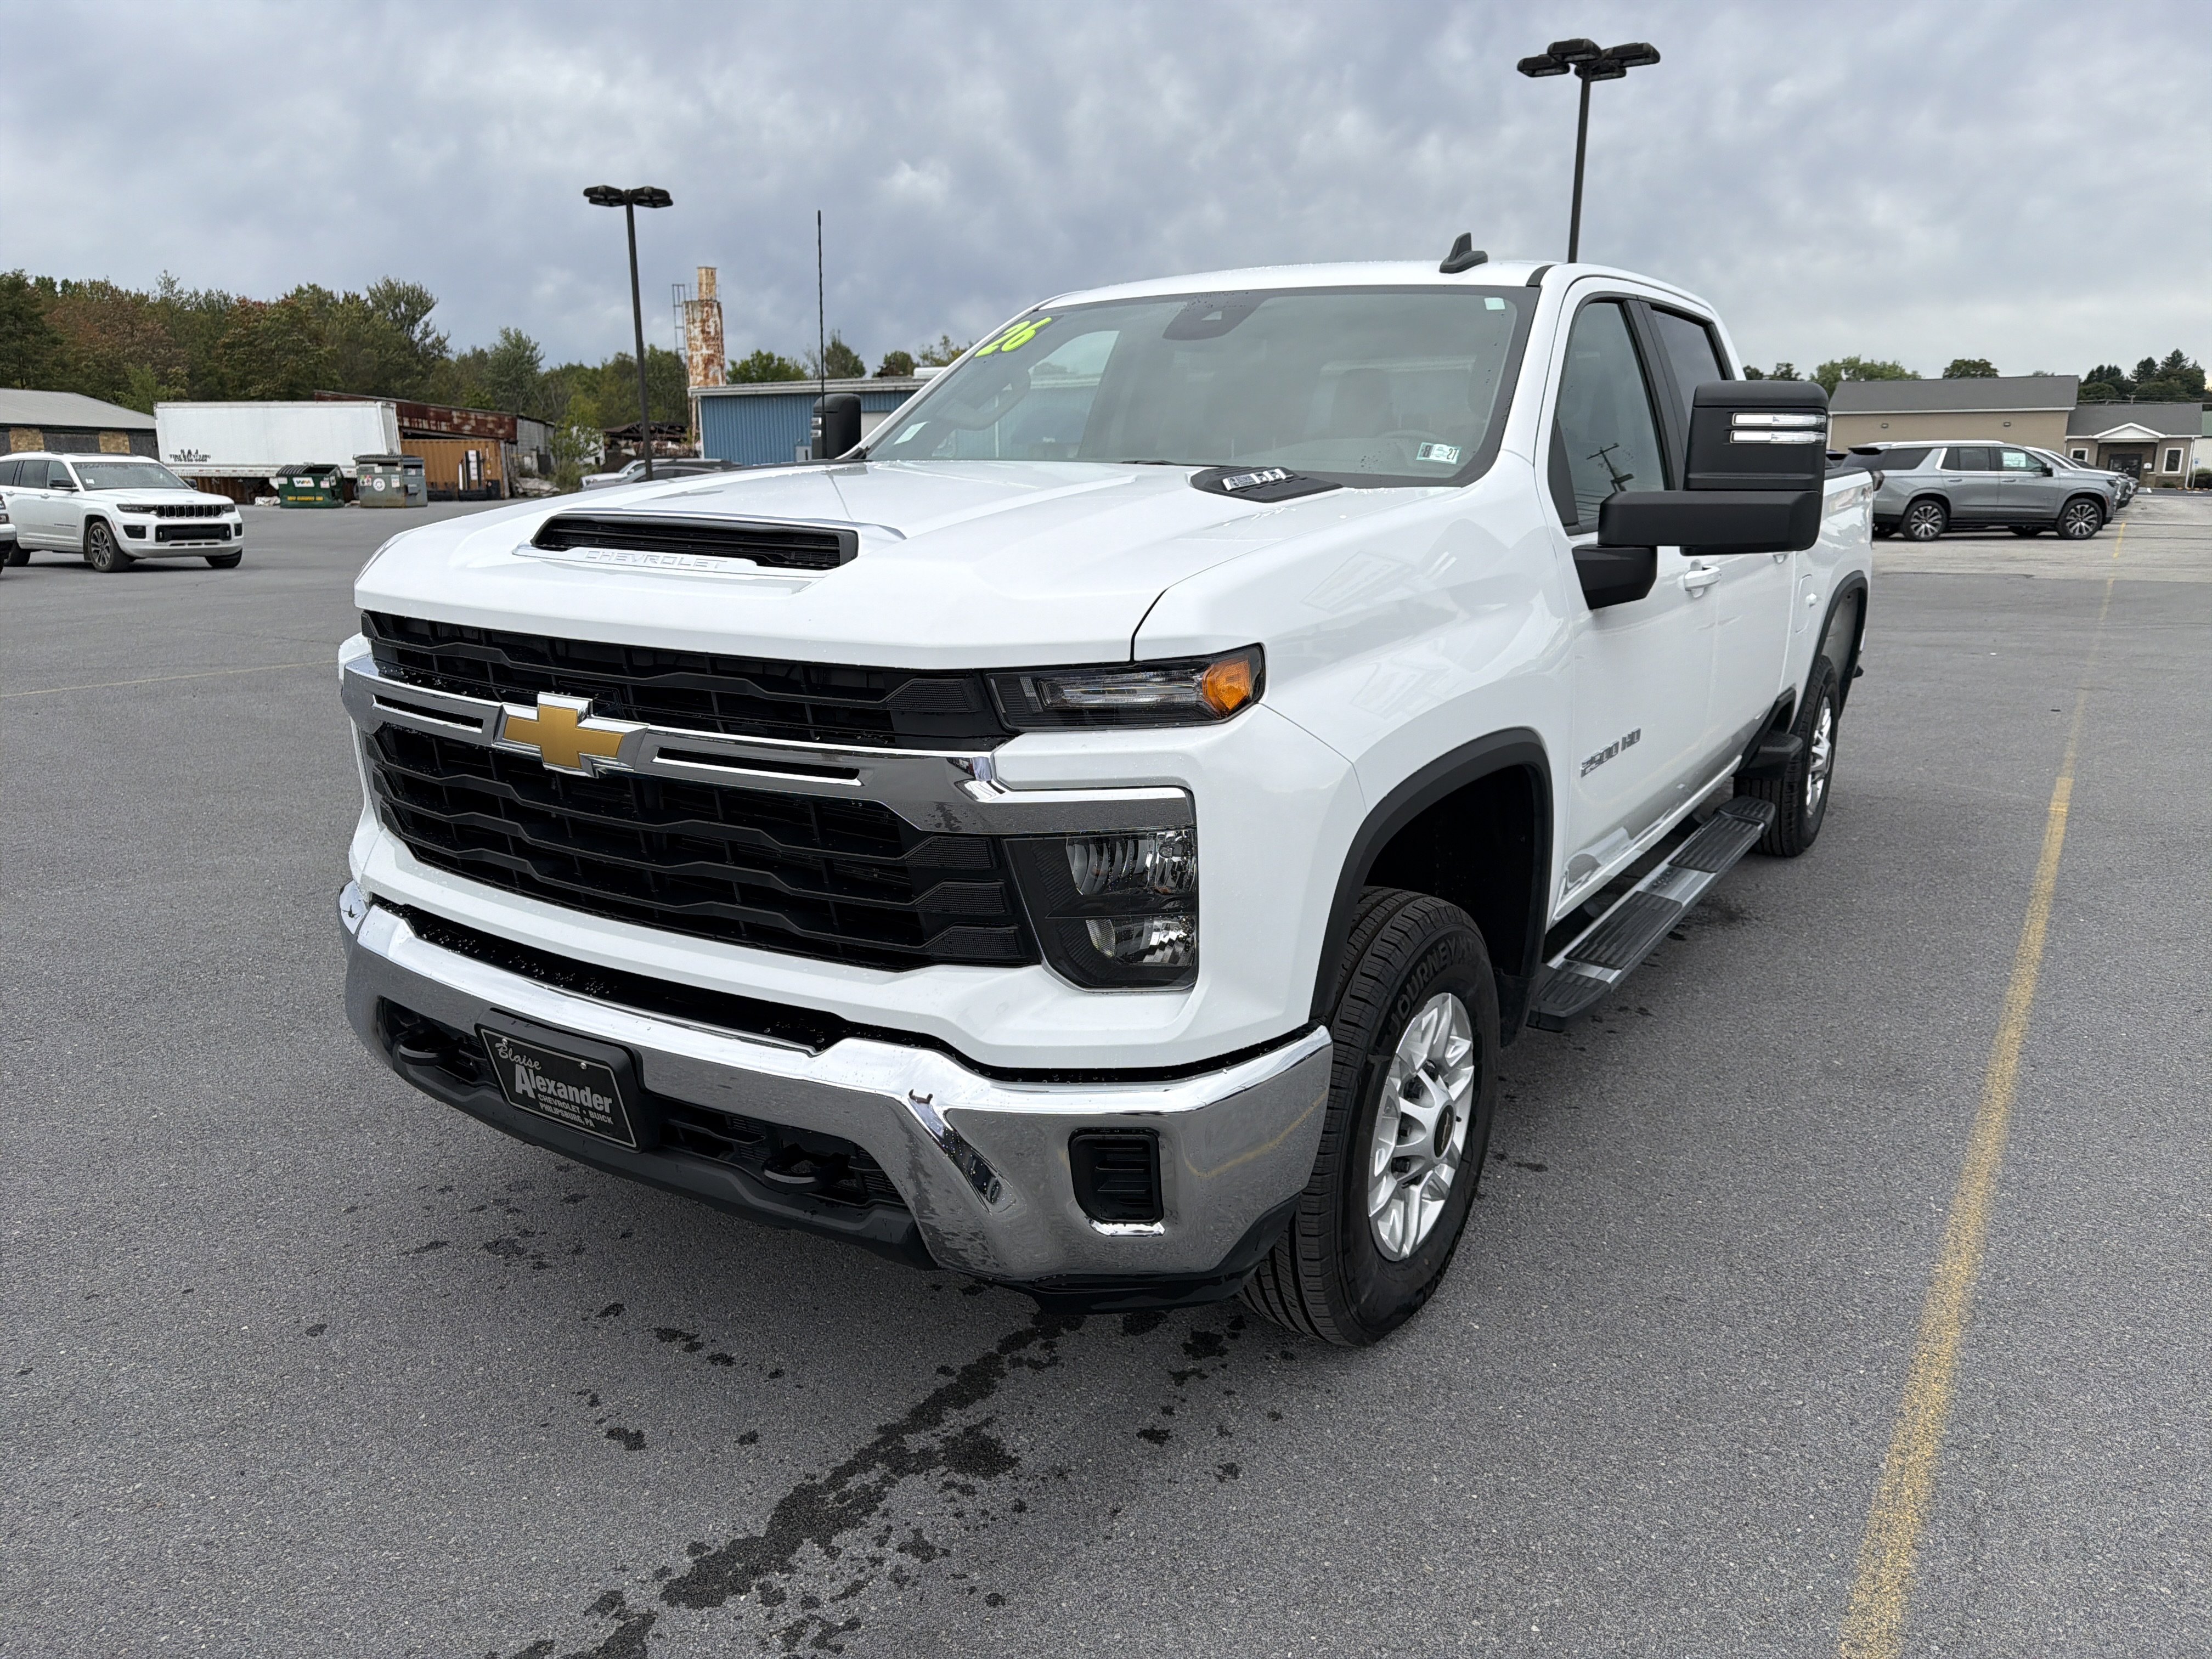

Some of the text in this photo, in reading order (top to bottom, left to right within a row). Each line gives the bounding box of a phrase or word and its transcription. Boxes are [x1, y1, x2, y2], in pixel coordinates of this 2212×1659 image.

[974, 317, 1053, 358] 26
[1446, 447, 1458, 460] 27
[584, 550, 728, 569] CHEVROLET
[1580, 725, 1641, 778] 2500 HD
[1388, 936, 1456, 1037] JOURNEY
[495, 1042, 542, 1070] Blaise
[515, 1063, 613, 1114] Alexander
[537, 1093, 614, 1125] CHEVROLET BUICK
[539, 1102, 596, 1128] PHILIPSBURG, PA
